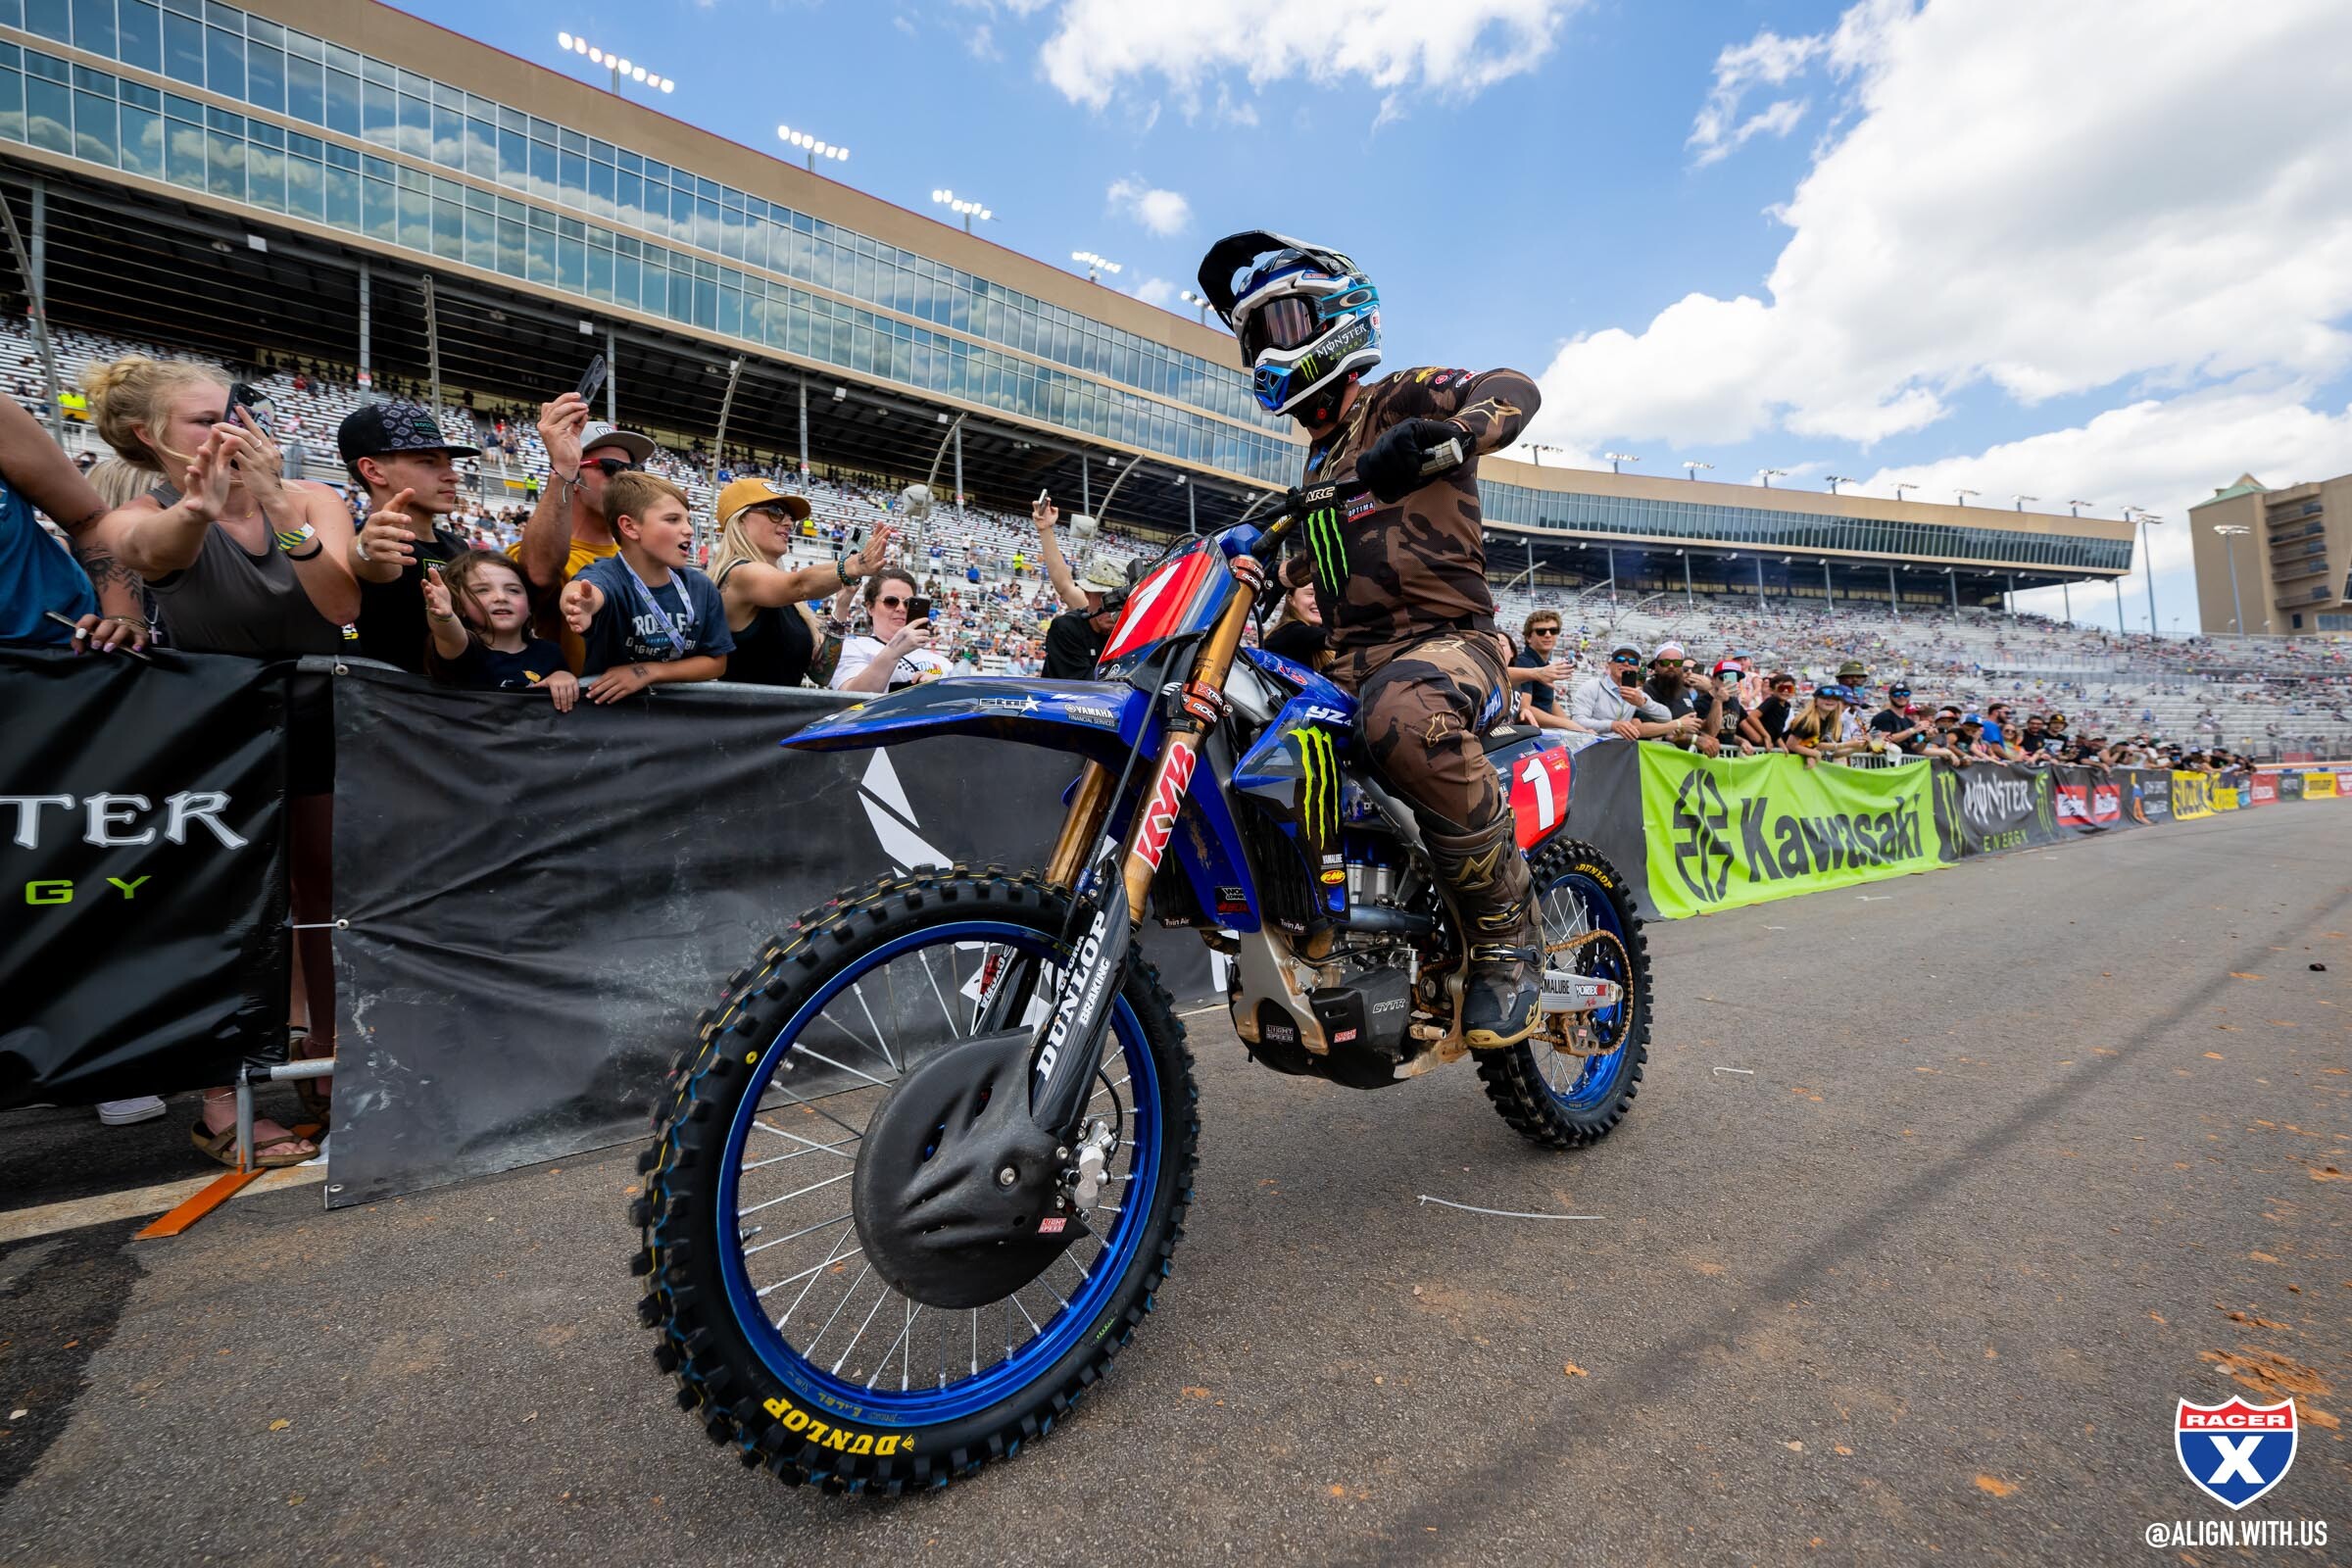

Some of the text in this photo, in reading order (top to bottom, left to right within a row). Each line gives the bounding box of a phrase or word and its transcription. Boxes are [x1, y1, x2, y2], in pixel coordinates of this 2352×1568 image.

[1316, 323, 1367, 359] MONSTER
[1305, 486, 1336, 504] ARC
[1348, 502, 1375, 517] OPTIMA
[1104, 561, 1184, 658] 1
[1198, 681, 1224, 707] XTRIG
[1067, 713, 1116, 727] FINANCIAL SERVICES
[1076, 705, 1114, 718] YAMAHA
[1133, 741, 1197, 874] KYB
[1521, 758, 1555, 831] 1
[1964, 772, 2034, 824] MONSTER
[1740, 792, 1925, 883] Kawasaki
[1983, 829, 2030, 853] ENERGY
[1578, 862, 1614, 890] DUNLOP
[1164, 916, 1191, 927] Twin Air
[1280, 917, 1306, 932] Twin Air
[1036, 909, 1107, 1082] DUNLOP
[1079, 956, 1113, 1028] BRAKING
[1540, 978, 1571, 995] AMALUBE
[1575, 984, 1598, 997] VORTEX
[1373, 998, 1406, 1014] GYTR
[762, 1396, 902, 1456] DUNLOP
